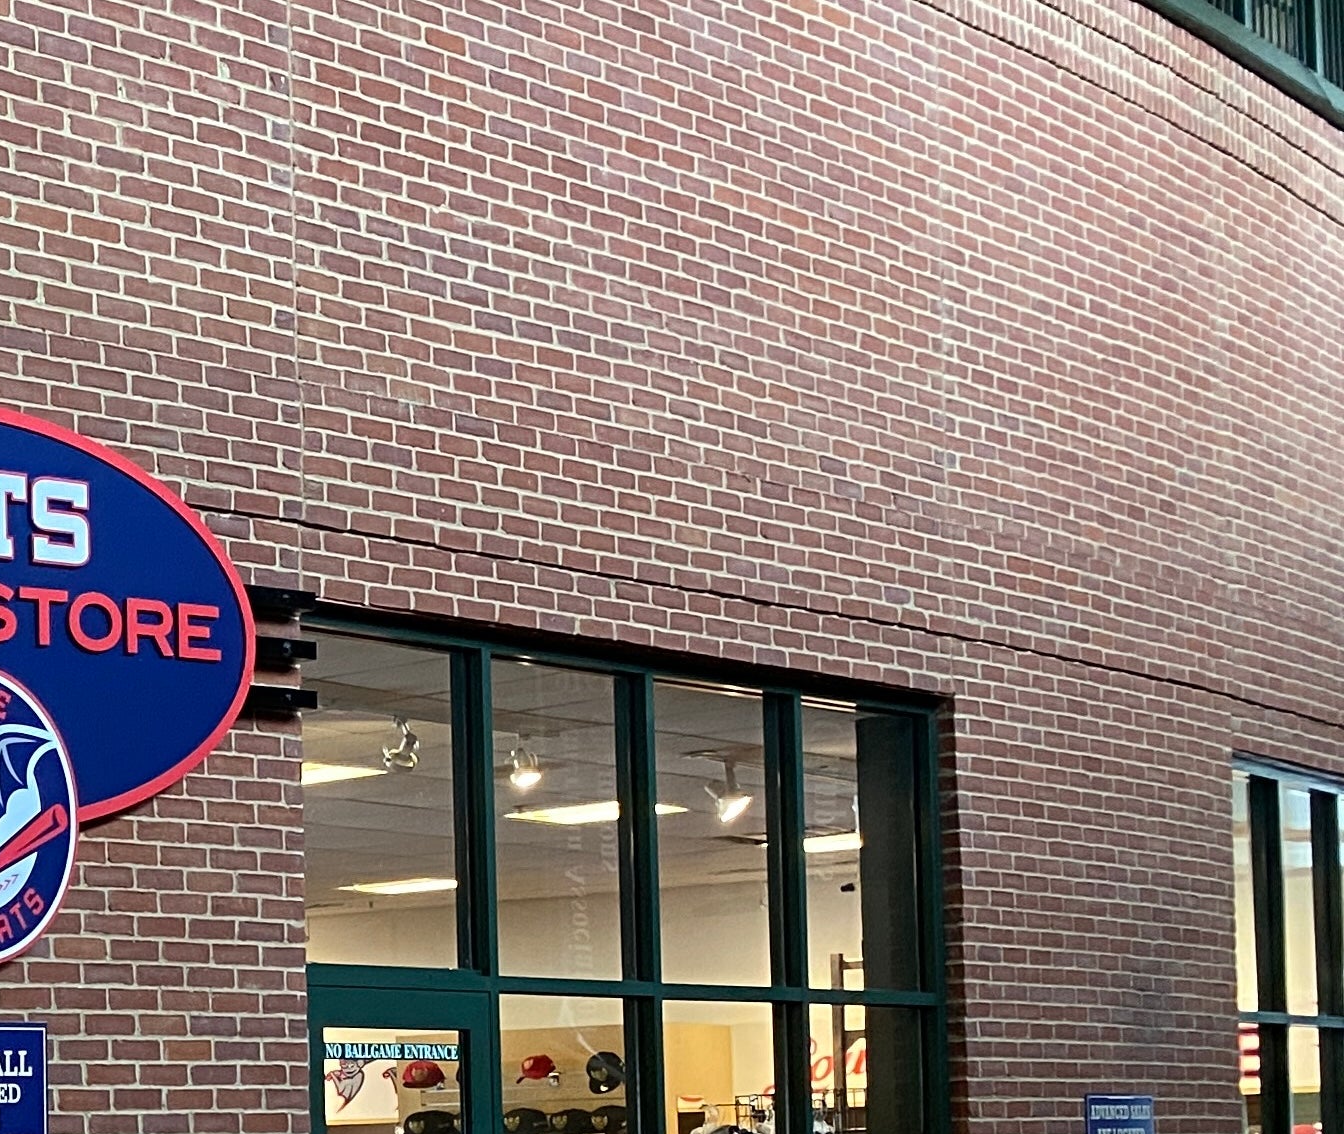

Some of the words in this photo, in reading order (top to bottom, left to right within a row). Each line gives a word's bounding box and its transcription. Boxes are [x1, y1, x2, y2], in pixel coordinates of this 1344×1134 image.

[325, 1043, 342, 1059] NO
[344, 1043, 402, 1060] BALLGAME
[404, 1044, 459, 1060] ENTRANCE
